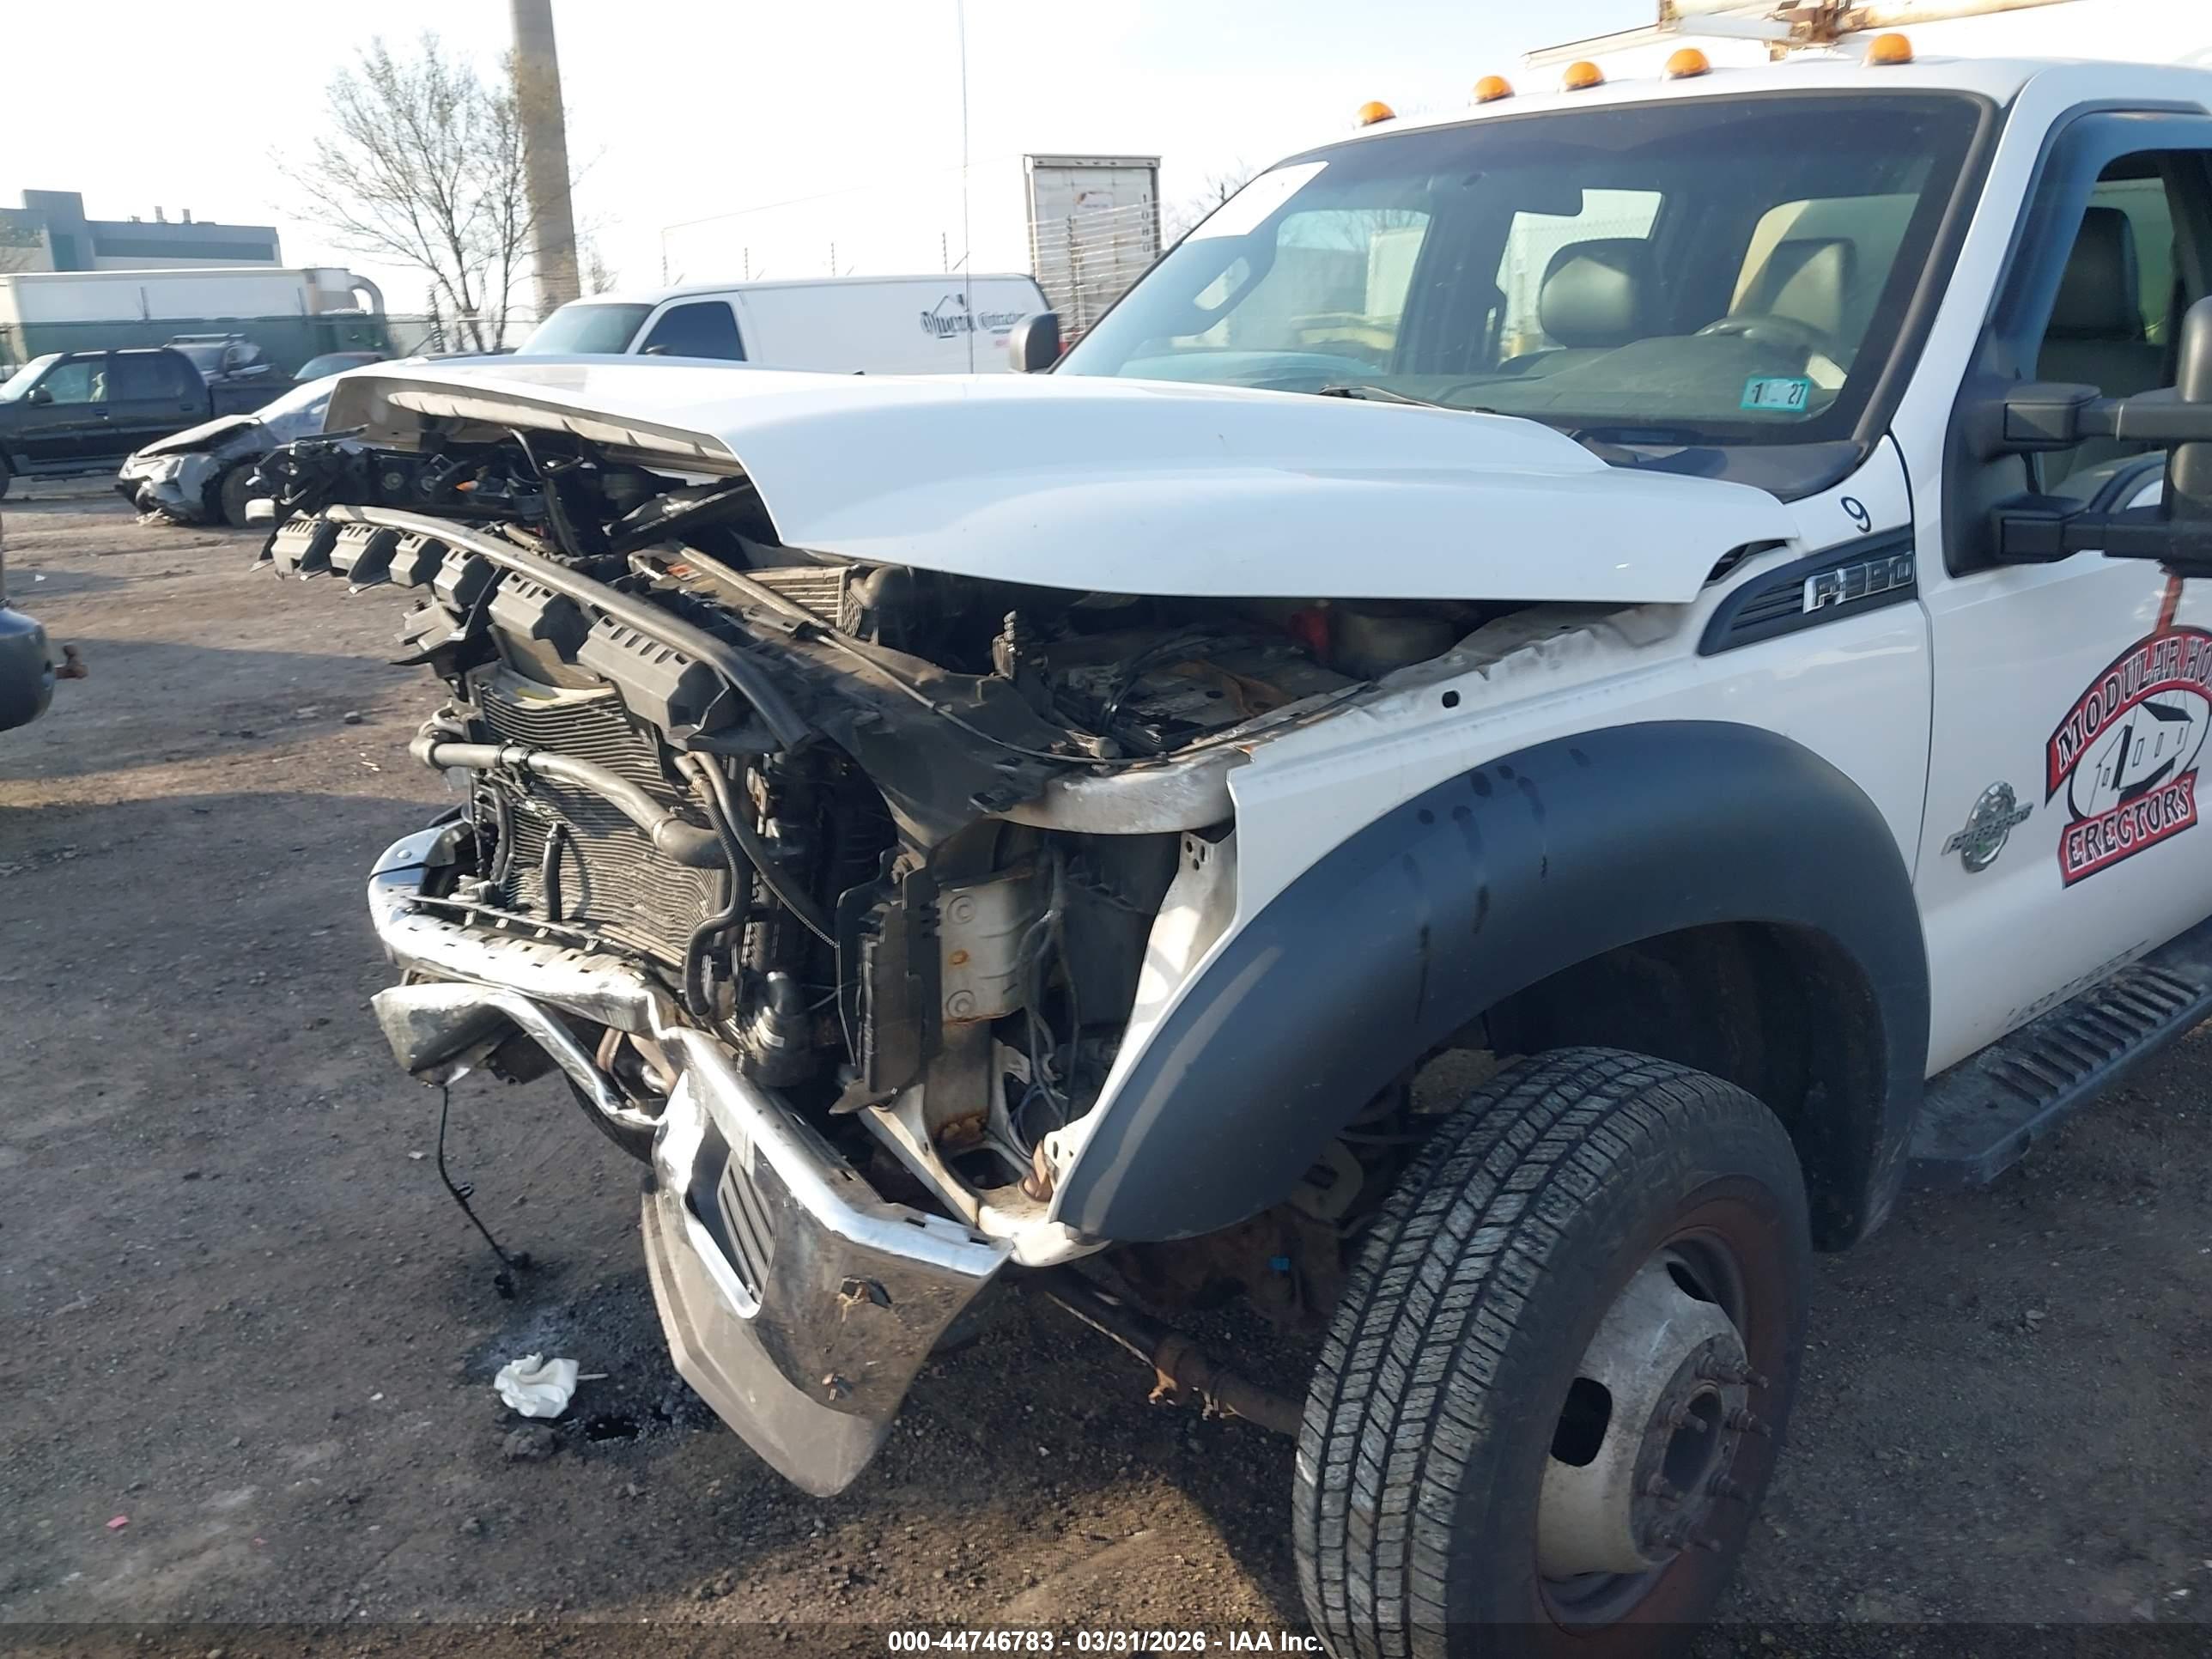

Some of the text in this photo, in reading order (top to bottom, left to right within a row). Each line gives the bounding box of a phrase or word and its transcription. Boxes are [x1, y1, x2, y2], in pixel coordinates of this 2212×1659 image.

[1787, 383, 1807, 406] 27
[1840, 495, 1872, 534] 9
[2055, 635, 2212, 775] MODULAR HO
[2065, 779, 2192, 873] ERECTORS
